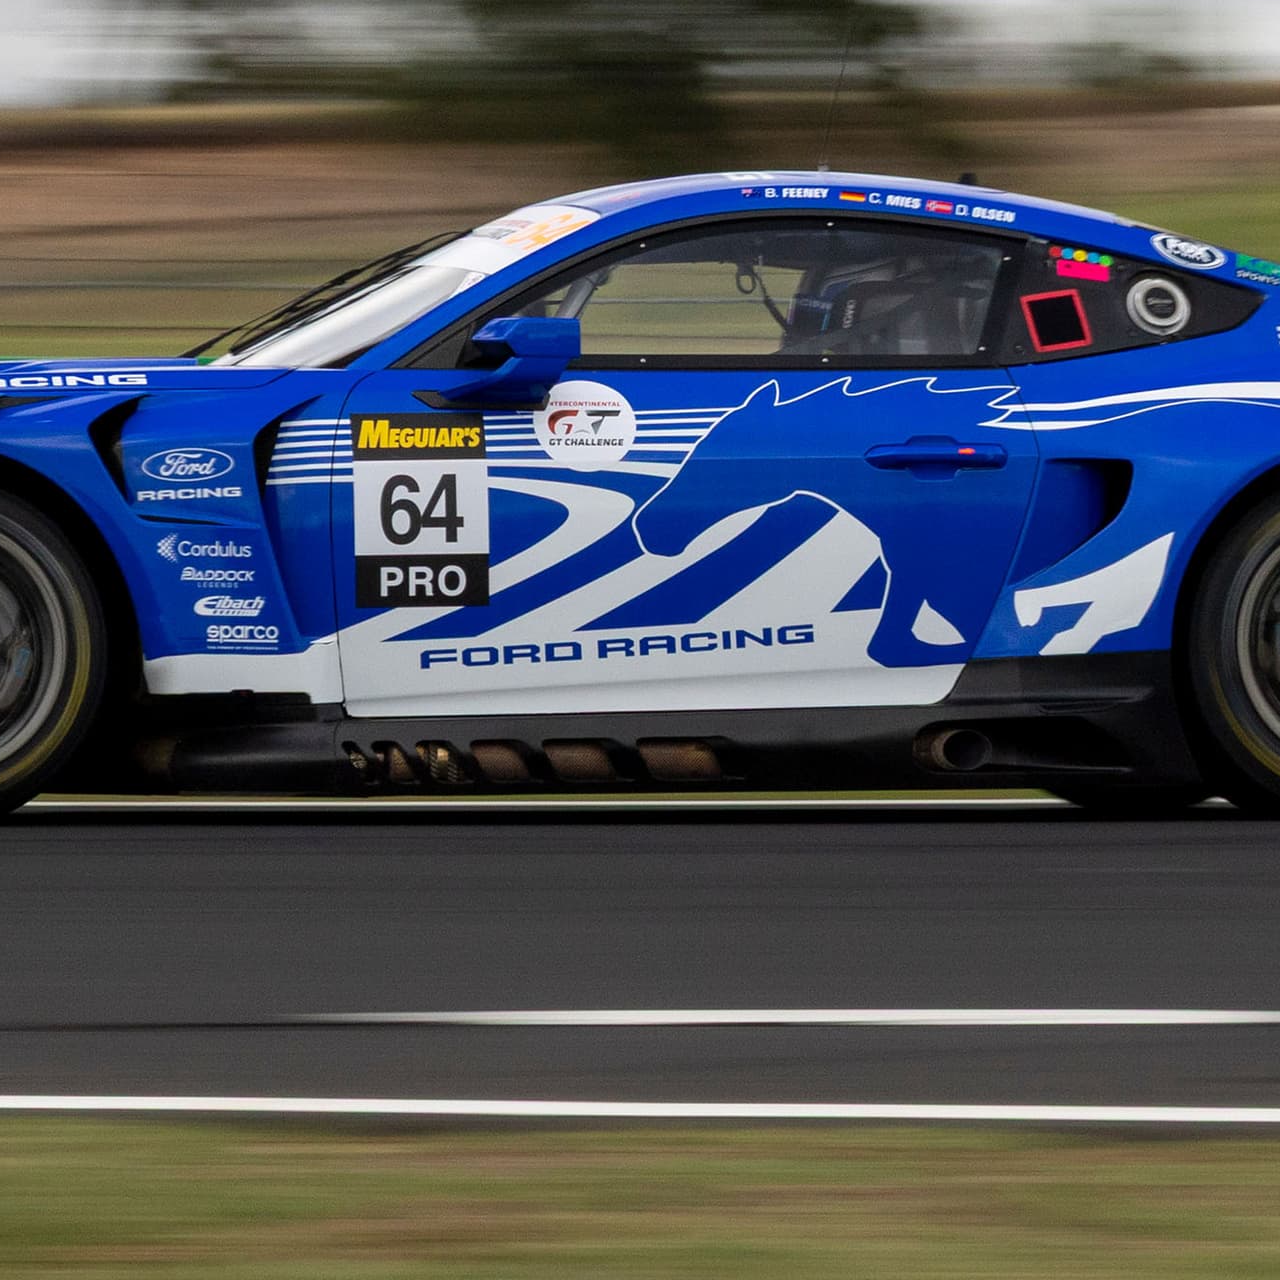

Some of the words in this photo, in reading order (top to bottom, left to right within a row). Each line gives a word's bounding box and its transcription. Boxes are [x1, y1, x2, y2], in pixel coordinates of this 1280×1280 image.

[782, 187, 829, 199] FEENEY
[869, 192, 882, 205] C.
[886, 194, 922, 210] MIES
[548, 438, 562, 446] GT
[564, 438, 624, 447] CHALLENGE
[159, 452, 216, 477] Ford
[137, 486, 243, 502] RACING
[380, 473, 465, 546] 64
[177, 540, 253, 559] Cordulus
[196, 581, 239, 589] LEGENDS
[379, 564, 467, 598] PRO
[193, 595, 266, 617] Eibach
[206, 624, 279, 644] sparco
[420, 640, 583, 670] FORD
[596, 623, 815, 660] RACING
